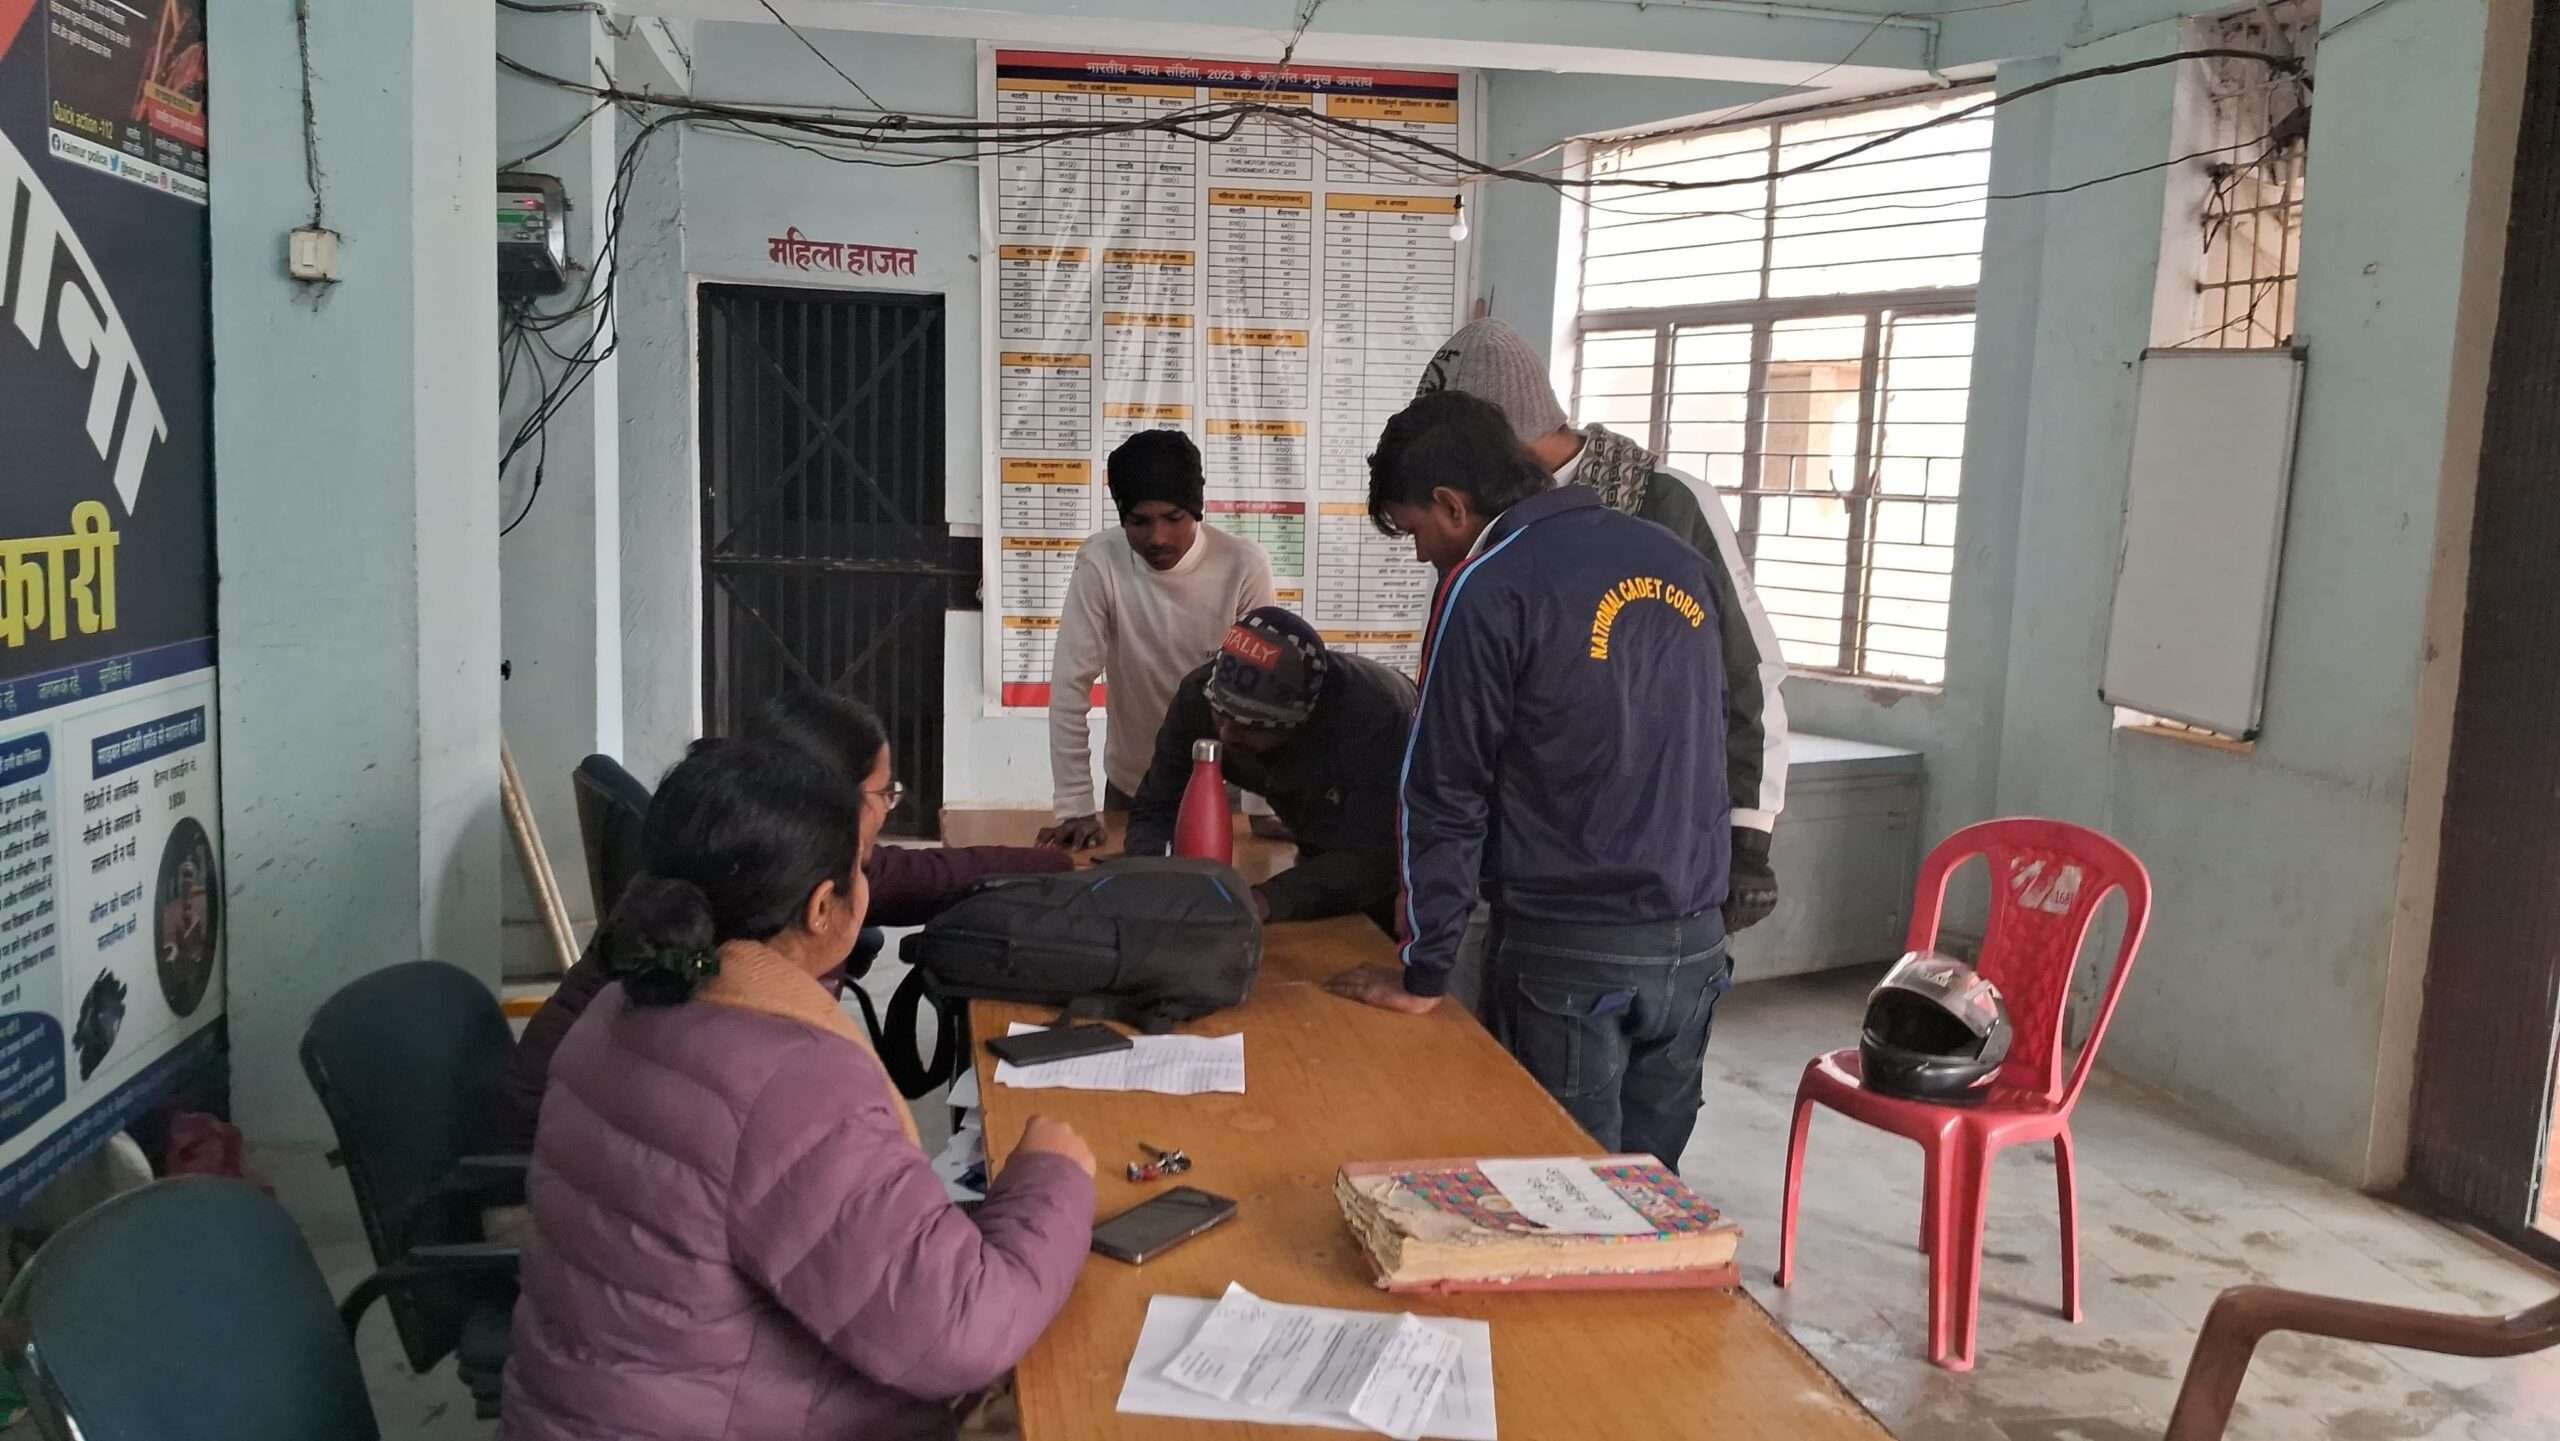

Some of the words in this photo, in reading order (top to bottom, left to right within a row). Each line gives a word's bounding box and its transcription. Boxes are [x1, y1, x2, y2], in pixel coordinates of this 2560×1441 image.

[1207, 69, 1235, 80] 2023
[768, 226, 845, 272] महिला
[847, 243, 918, 277] हाजत
[1589, 588, 1625, 660] NATIONAL
[1618, 577, 1663, 602] CADET
[1665, 583, 1705, 628] CORPS
